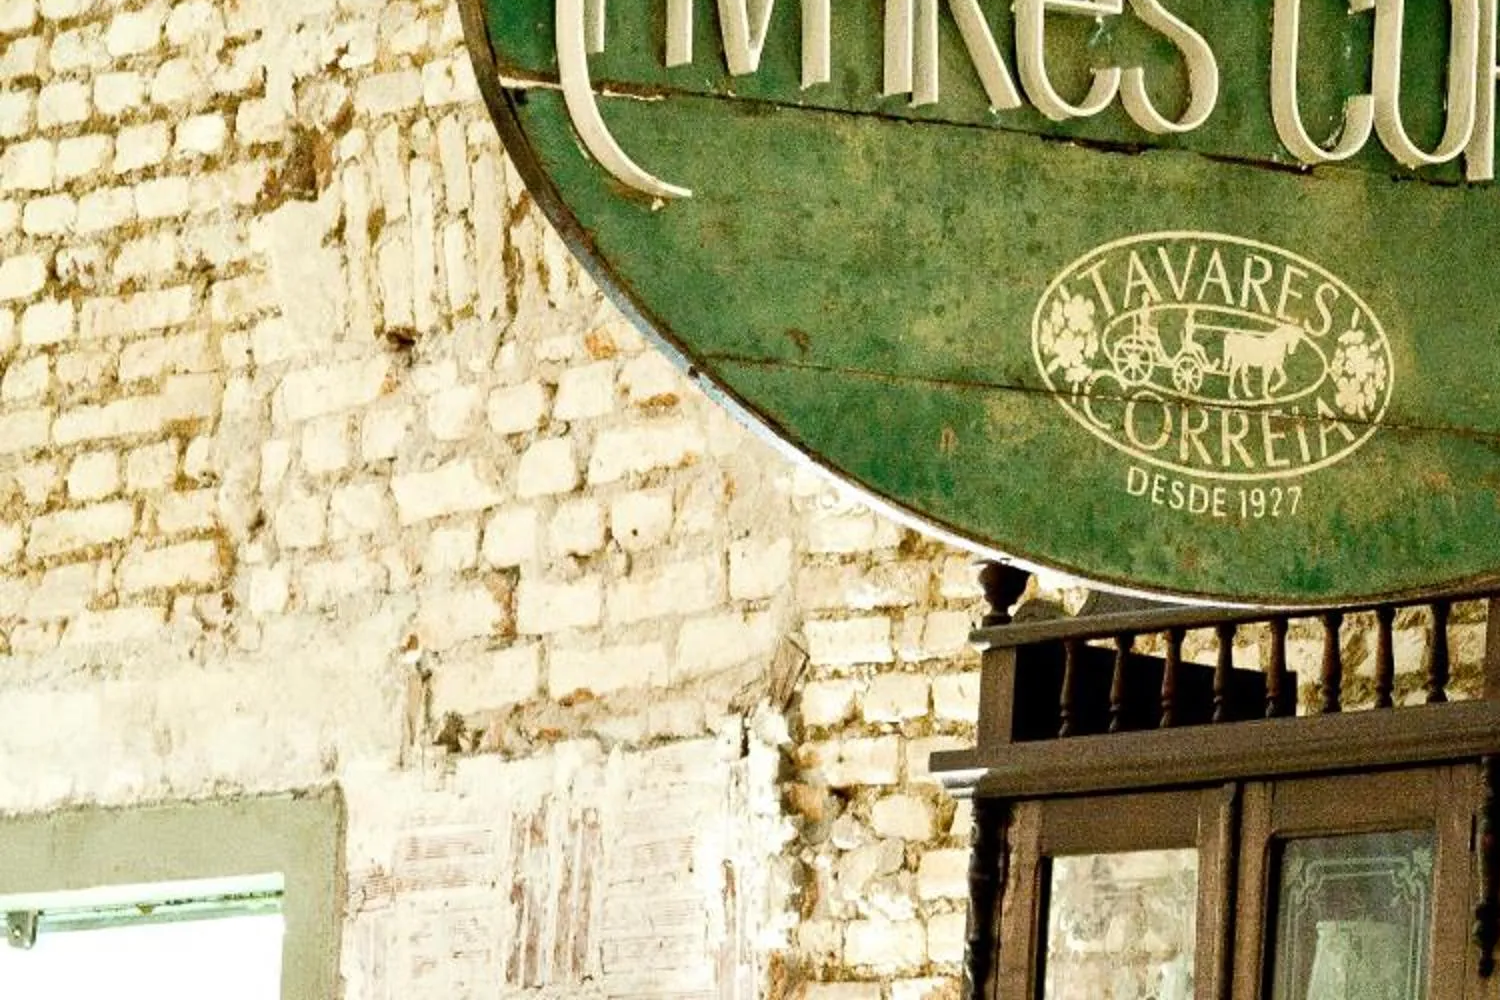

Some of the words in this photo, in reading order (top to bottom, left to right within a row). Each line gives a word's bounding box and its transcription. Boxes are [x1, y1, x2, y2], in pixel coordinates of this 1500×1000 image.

[1076, 246, 1339, 338] TAVARES
[1083, 369, 1355, 469] CORREIA
[1126, 466, 1227, 517] DESDE
[1239, 485, 1302, 519] 1927
